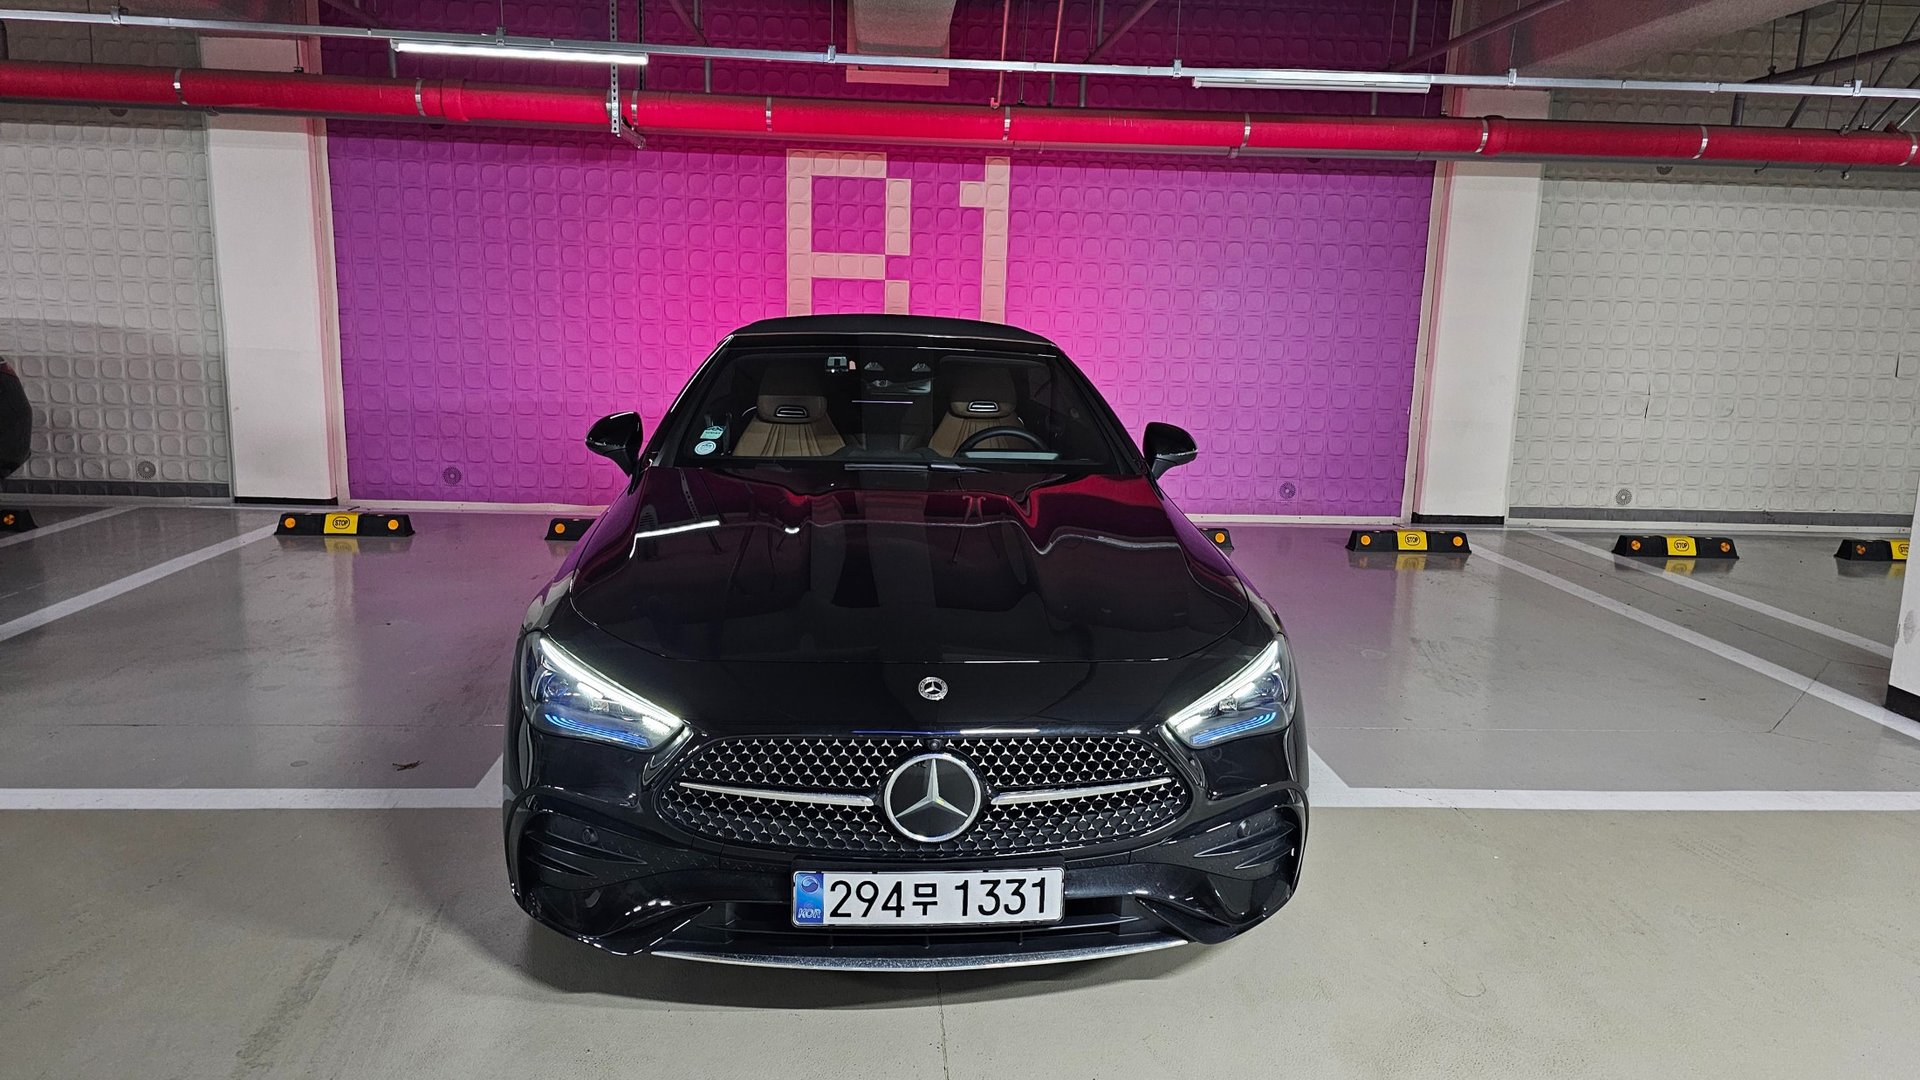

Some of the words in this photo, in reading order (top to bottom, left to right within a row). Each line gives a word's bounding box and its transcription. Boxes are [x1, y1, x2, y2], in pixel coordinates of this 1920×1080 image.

[334, 519, 349, 527] STOP
[829, 879, 938, 918] 294무
[954, 877, 1047, 917] 1331
[798, 908, 821, 919] KOR
